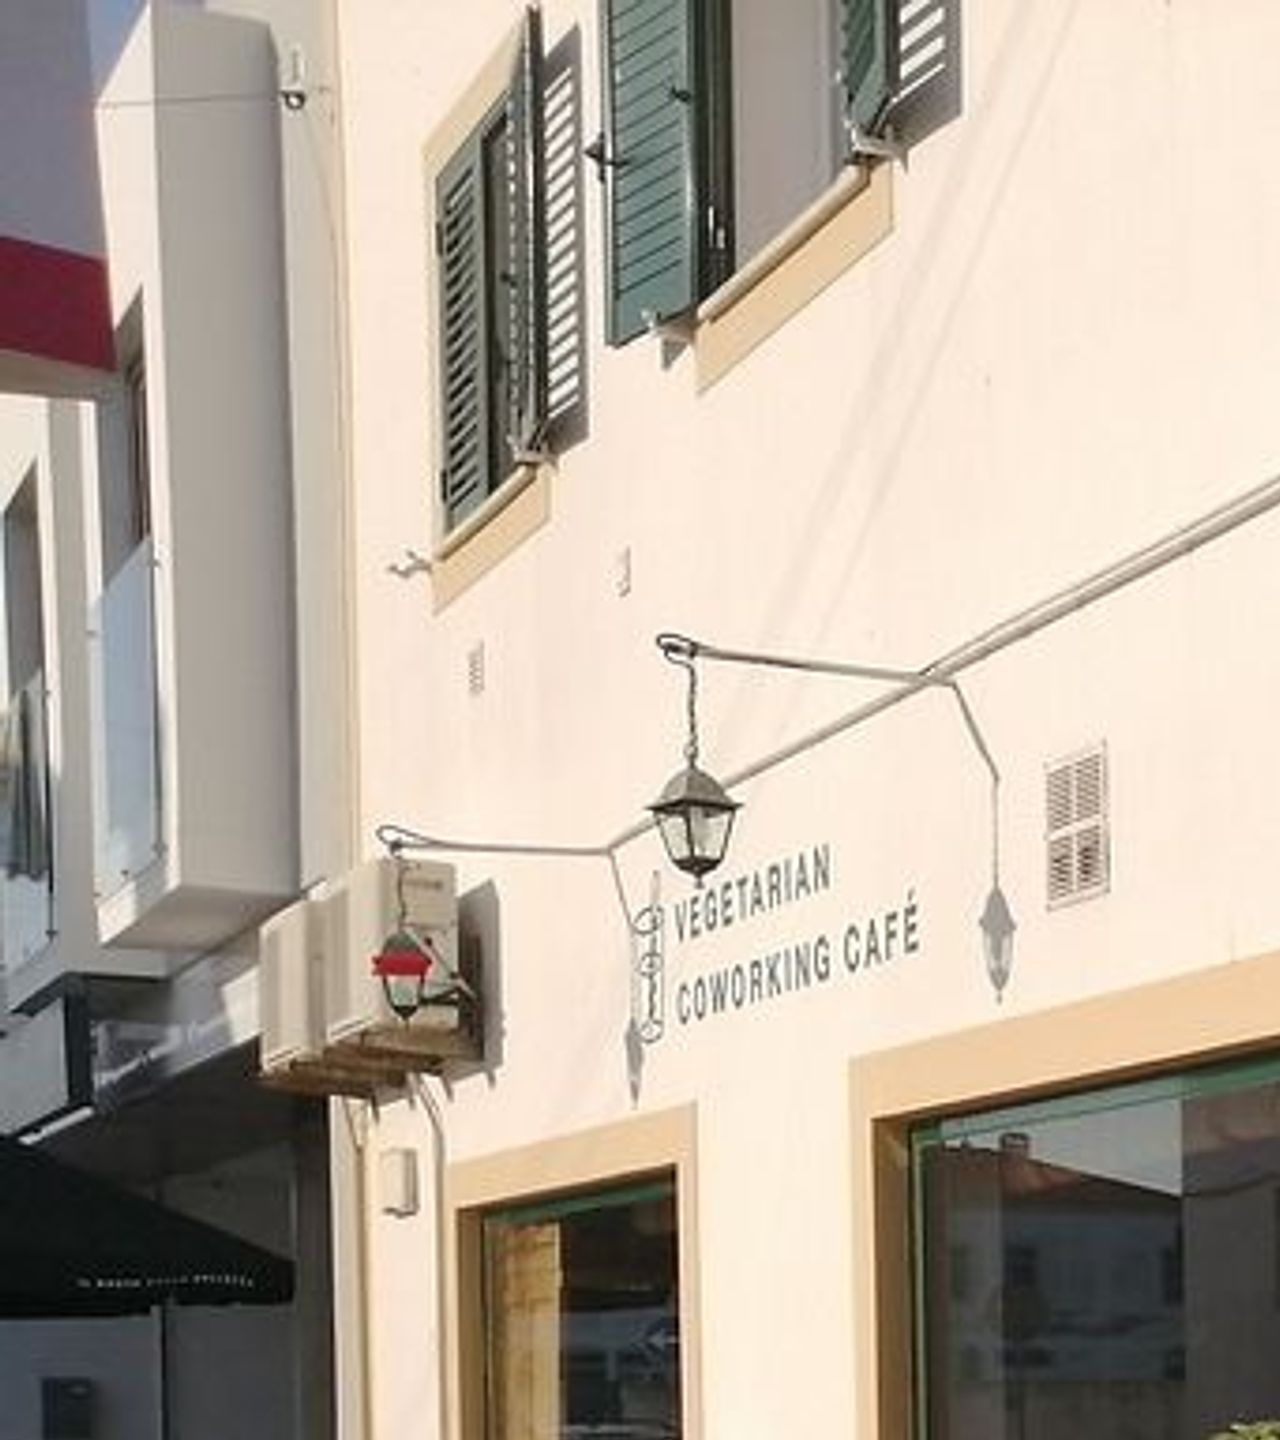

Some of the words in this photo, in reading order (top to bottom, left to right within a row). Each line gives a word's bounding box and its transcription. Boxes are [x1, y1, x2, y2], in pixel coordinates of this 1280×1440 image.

[674, 843, 831, 943] VEGETARIAN
[675, 934, 831, 1025] COWORKING
[842, 887, 920, 973] CAFÉ
